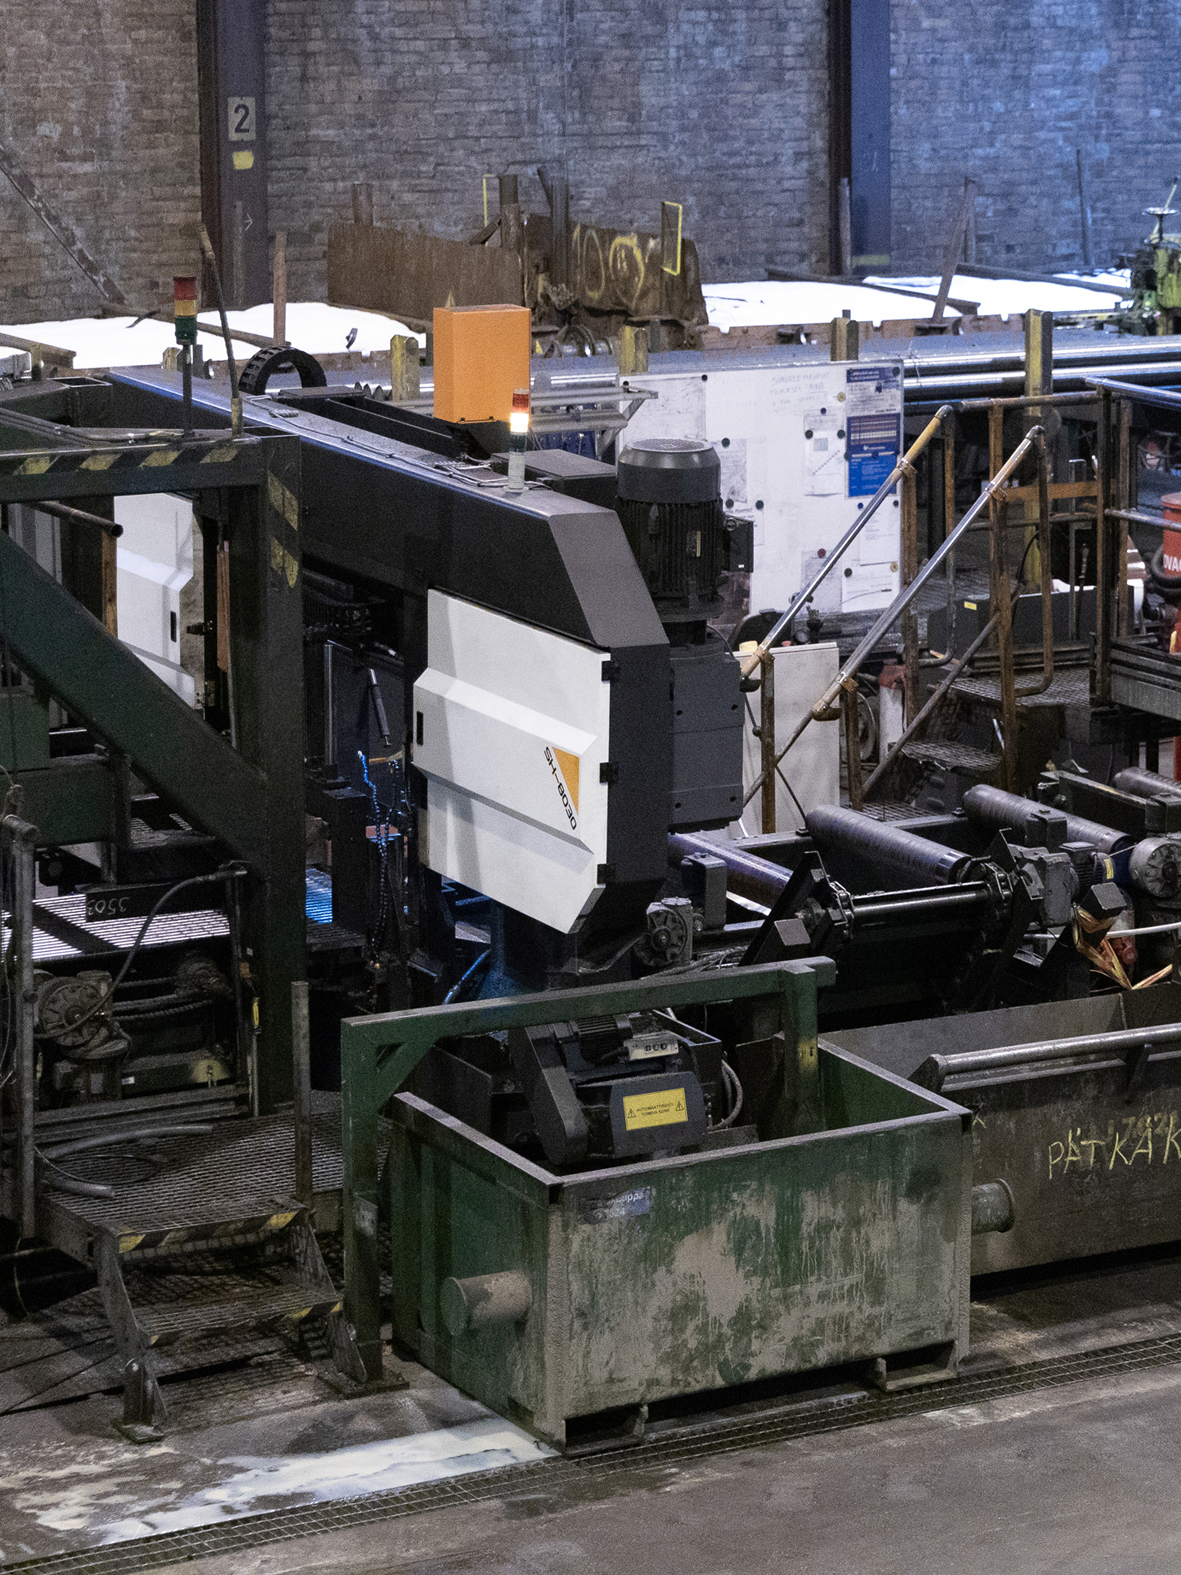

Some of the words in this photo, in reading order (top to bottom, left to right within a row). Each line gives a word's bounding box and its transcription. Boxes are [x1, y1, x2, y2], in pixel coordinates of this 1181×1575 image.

[234, 103, 250, 133] 2
[544, 746, 577, 830] SH-8030
[636, 1102, 674, 1112] AUTOMAATTISESTI
